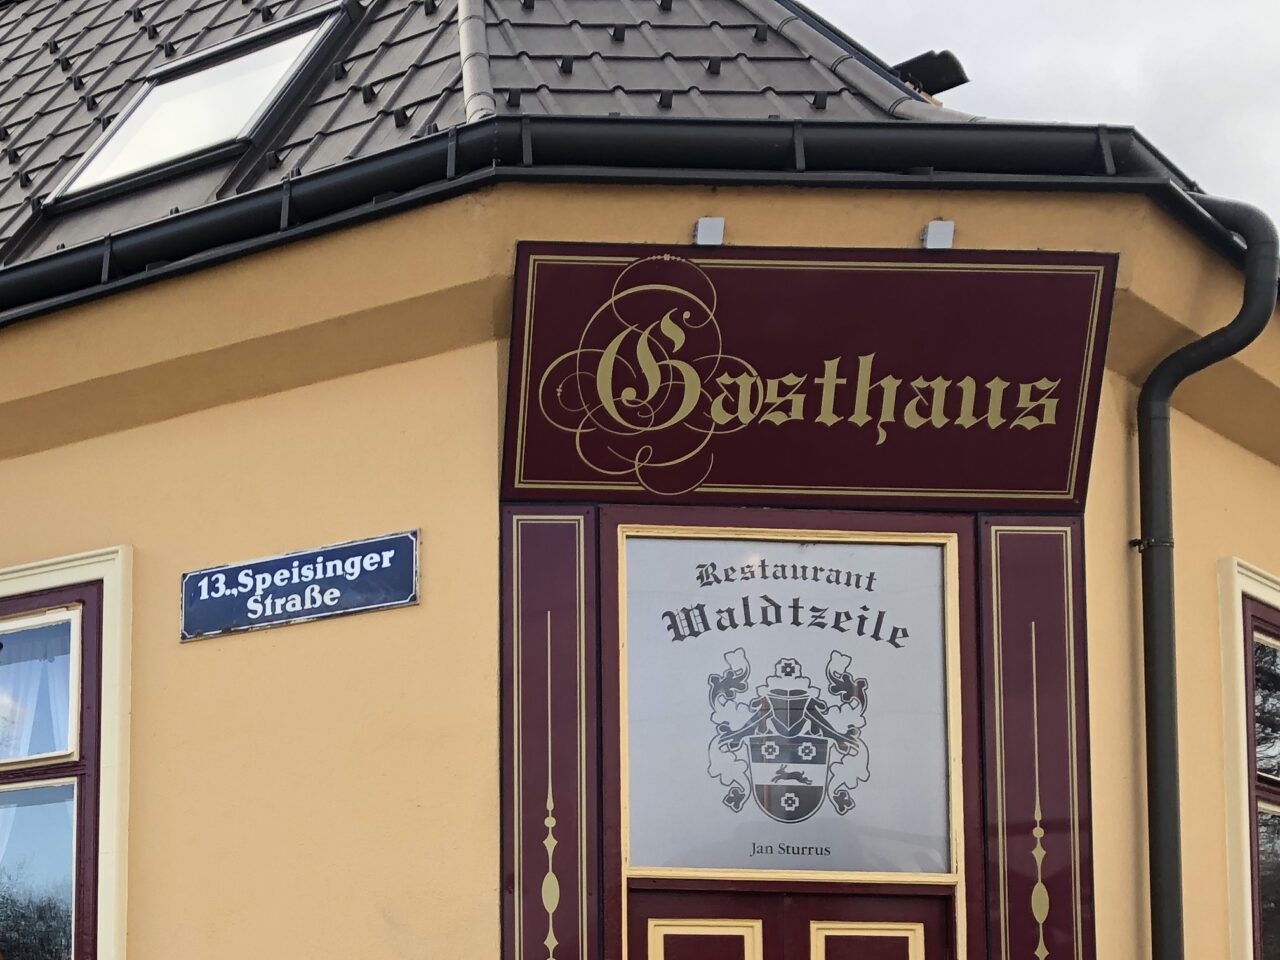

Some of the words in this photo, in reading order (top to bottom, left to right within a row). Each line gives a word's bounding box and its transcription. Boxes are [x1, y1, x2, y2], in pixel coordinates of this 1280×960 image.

[582, 304, 1062, 450] Gasthaus
[237, 549, 395, 597] Speisinger
[695, 558, 878, 593] Restaurant
[246, 583, 342, 619] Straße
[661, 594, 910, 649] Waldtzeile
[749, 842, 774, 857] Jan
[777, 842, 831, 856] Sturrus
